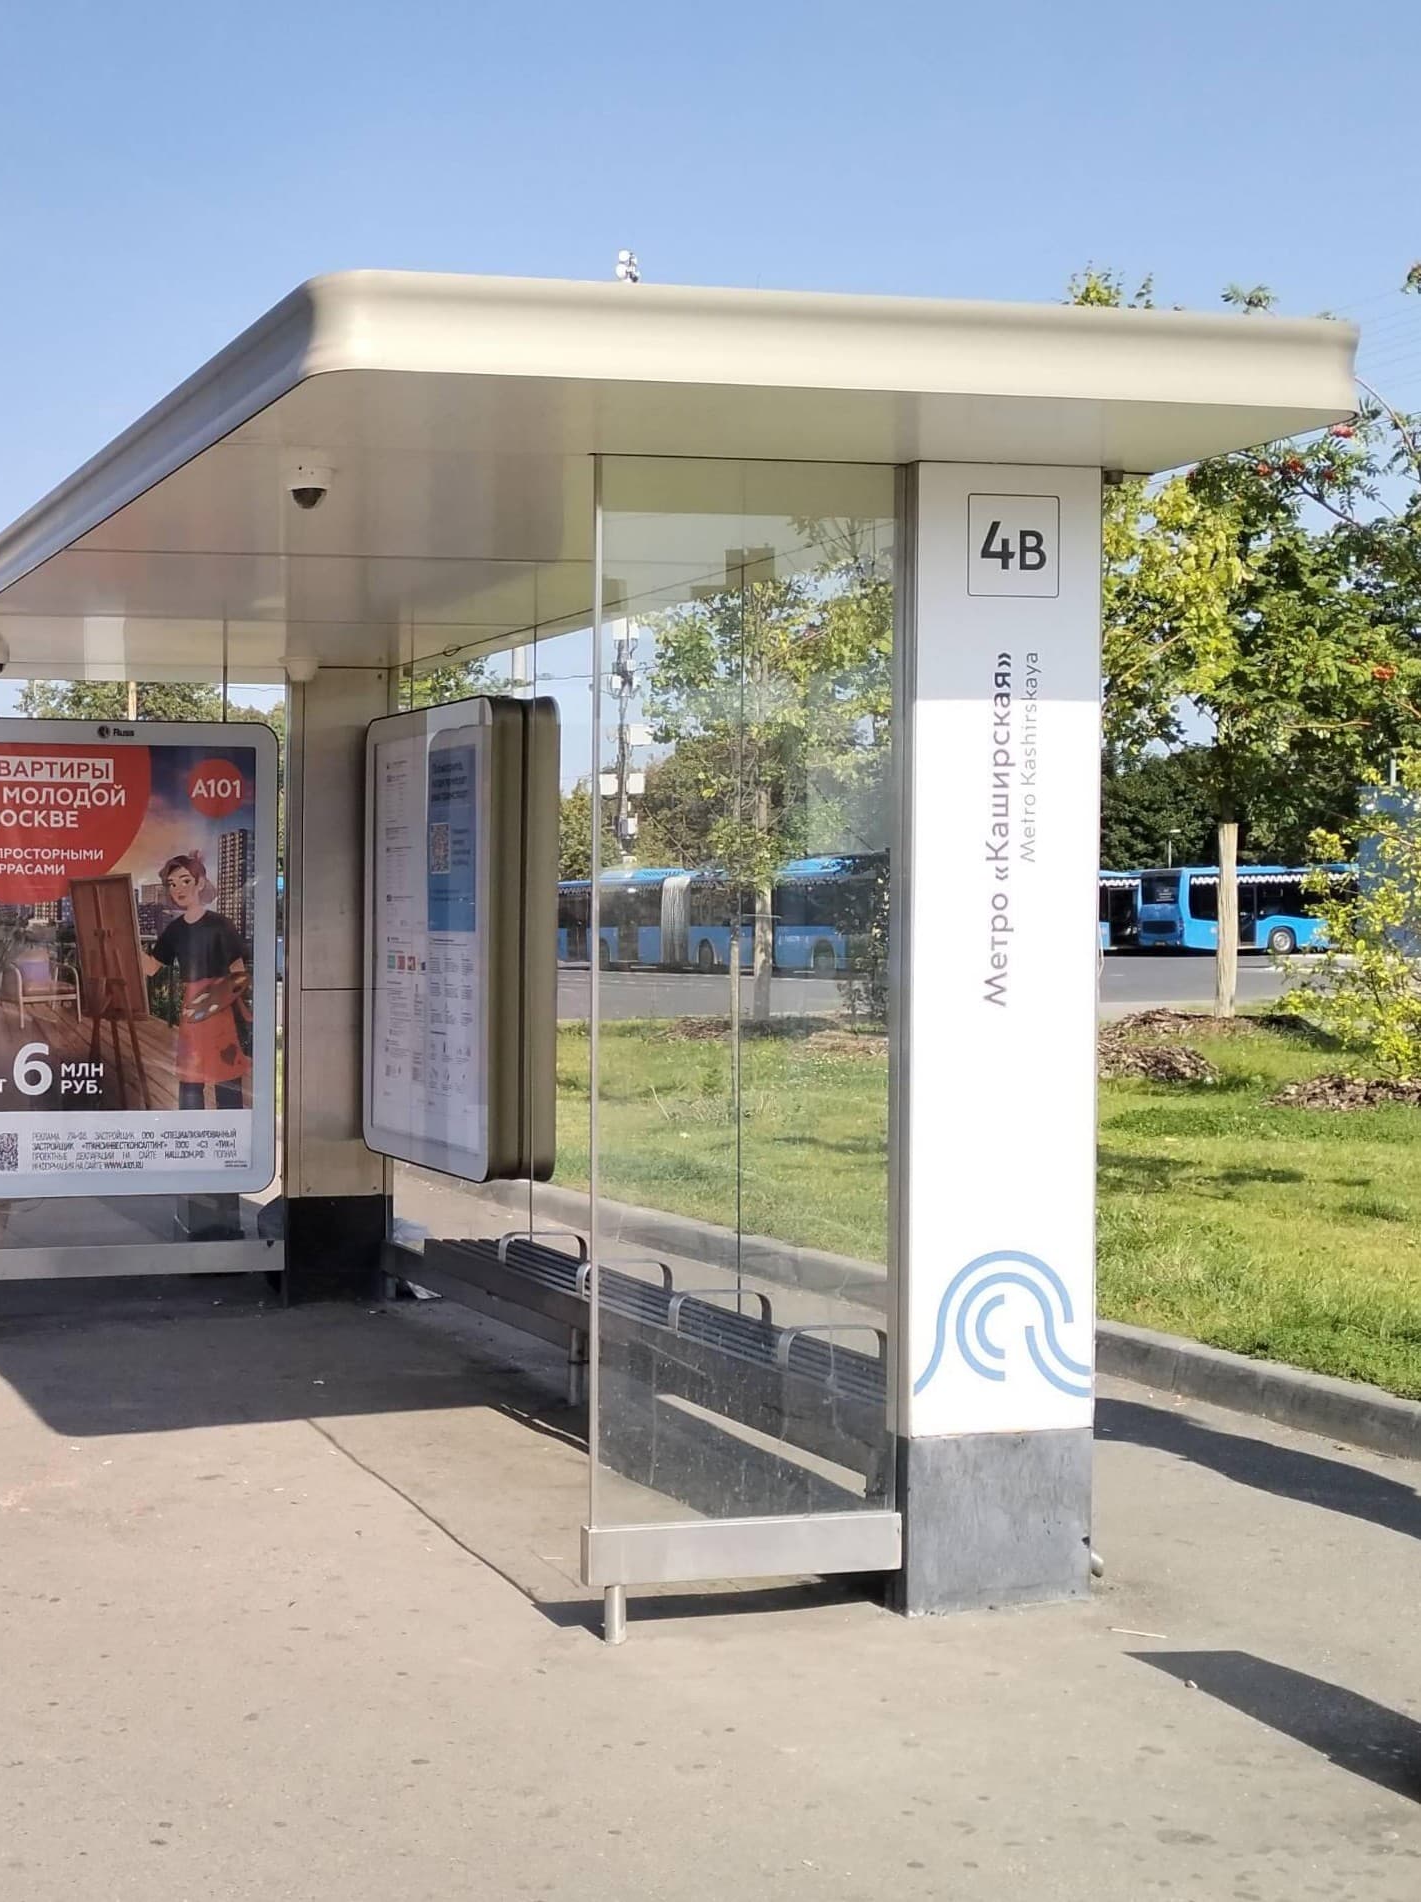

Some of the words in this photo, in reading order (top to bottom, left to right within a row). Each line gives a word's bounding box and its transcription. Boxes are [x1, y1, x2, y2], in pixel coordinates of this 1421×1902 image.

[1020, 652, 1043, 786] Kashirskaya
[2, 784, 126, 809] МОЛОДОЙ
[985, 652, 1016, 881] «Каширская»
[1020, 794, 1037, 863] Metro
[983, 893, 1015, 1008] Метро
[12, 1042, 53, 1096] 6
[60, 1062, 105, 1078] МЛН
[60, 1079, 104, 1095] РУБ.
